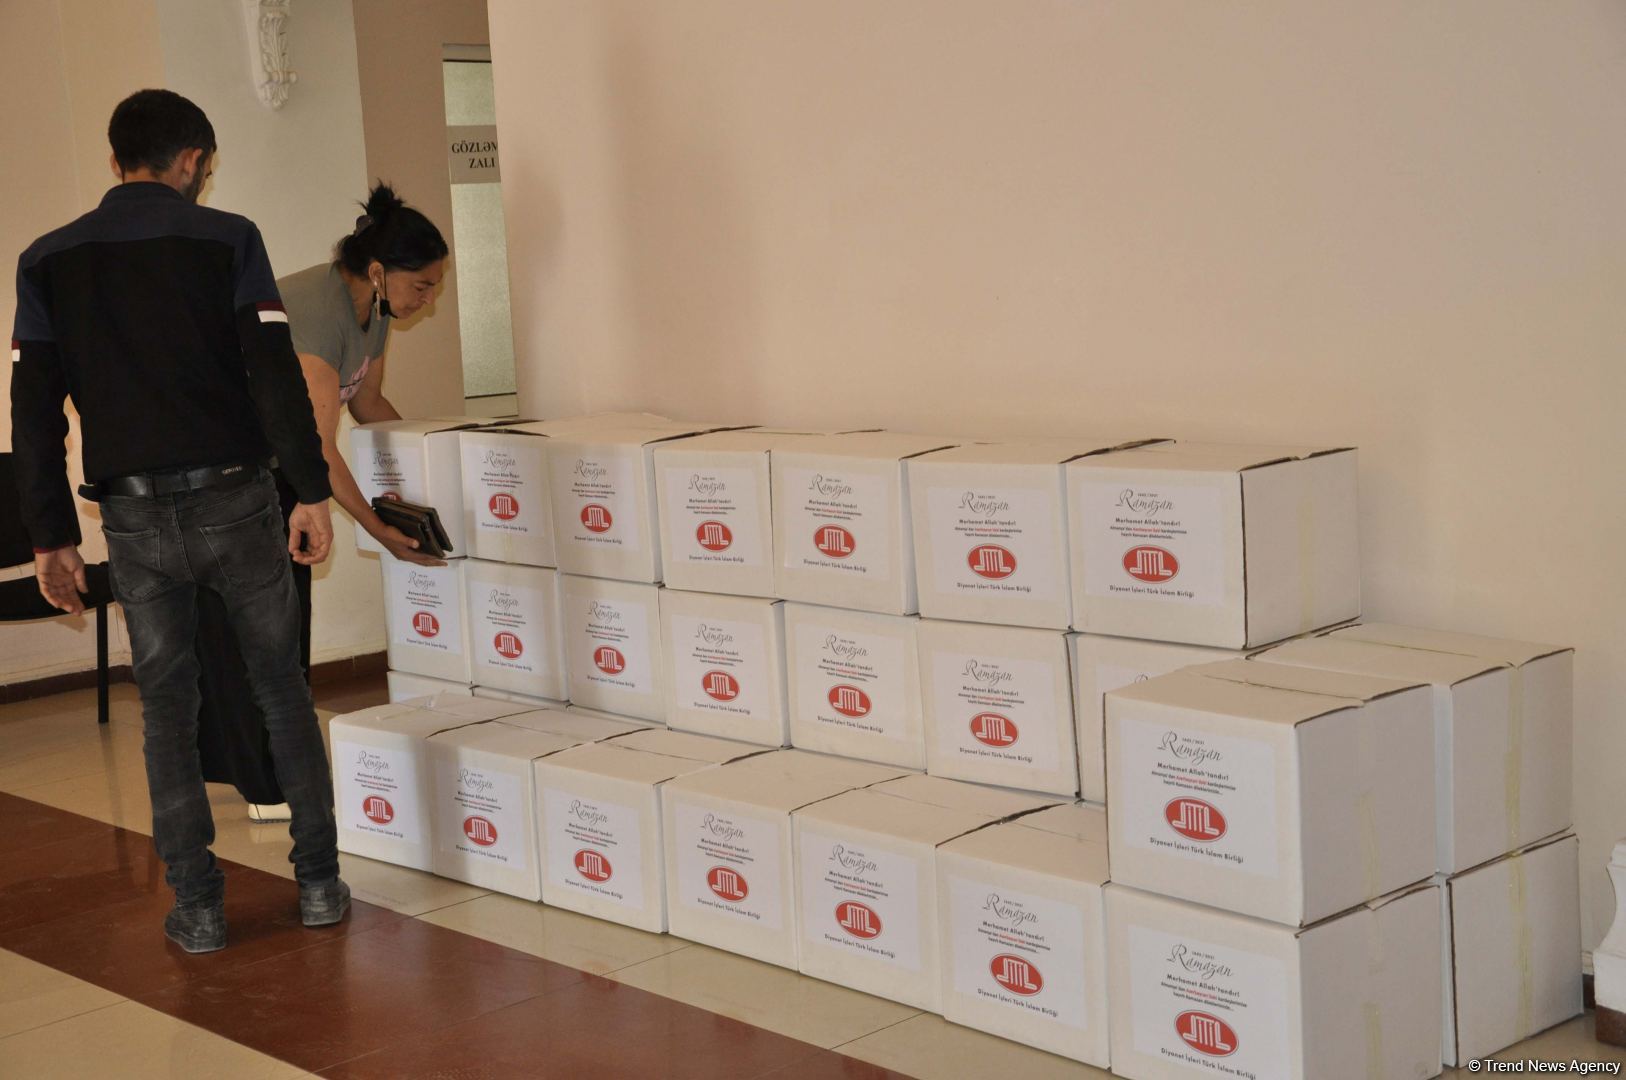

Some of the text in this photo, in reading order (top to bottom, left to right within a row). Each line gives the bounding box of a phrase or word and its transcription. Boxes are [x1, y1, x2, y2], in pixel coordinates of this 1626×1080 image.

[468, 157, 496, 169] ZALI
[958, 491, 1010, 517] Ramazan
[1115, 488, 1174, 517] Ramazan
[962, 659, 1013, 686] Ramazan
[1157, 731, 1222, 766] Ramazan
[1157, 762, 1187, 773] Merhamet
[1150, 837, 1173, 847] Diyanet
[1191, 846, 1204, 854] Türk
[828, 844, 878, 875] Ramazan
[982, 893, 1038, 926] Ramazan
[1166, 943, 1232, 980] Ramazan
[1167, 974, 1197, 986] Merhamet
[1161, 1047, 1184, 1059] Diyanet
[1202, 1060, 1215, 1068] Türk
